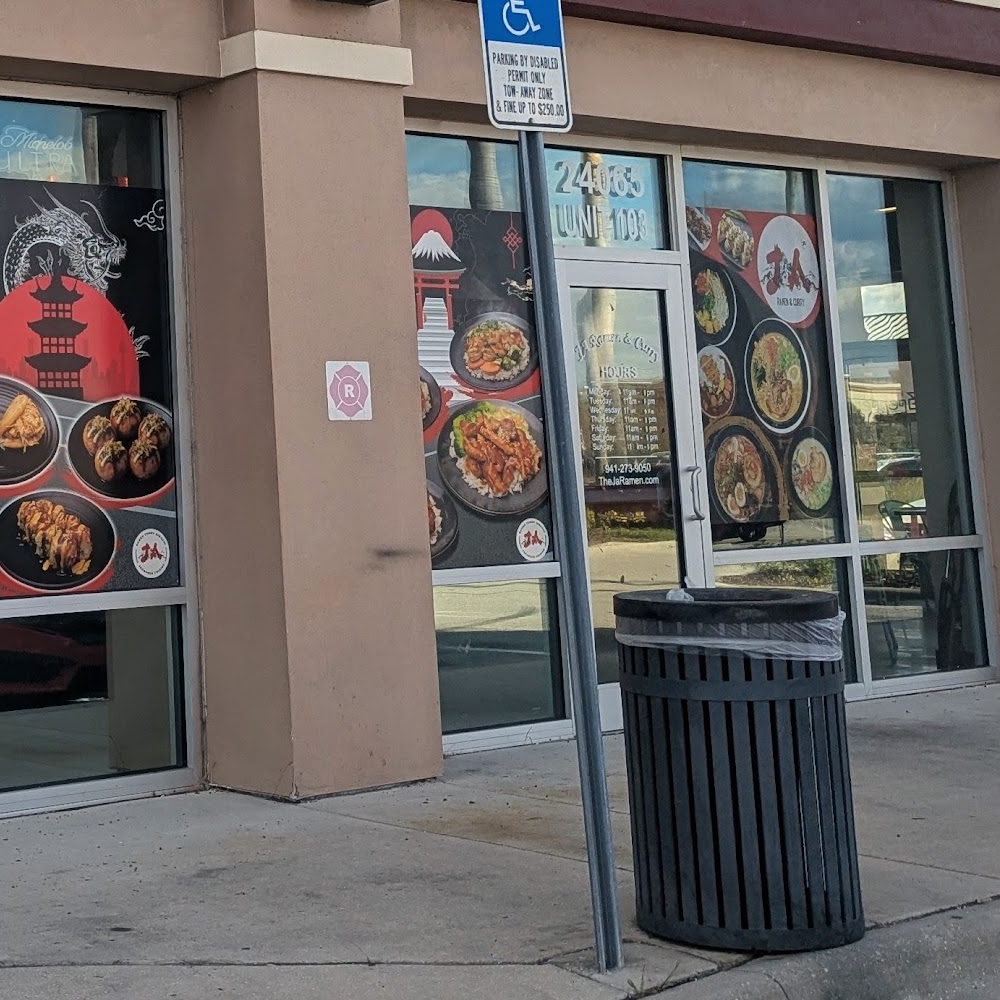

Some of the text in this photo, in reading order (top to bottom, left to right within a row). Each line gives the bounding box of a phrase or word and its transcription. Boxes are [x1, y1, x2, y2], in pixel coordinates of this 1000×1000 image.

[492, 52, 559, 69] PARKING BY DISABLED
[507, 69, 546, 84] PERMIT ONLY
[538, 87, 554, 100] ZONE
[496, 100, 565, 116] & FINE UP TO $250.00
[0, 125, 74, 151] Michelob
[556, 159, 646, 198] 24065
[558, 203, 610, 239] UNIT
[766, 243, 811, 295] JA
[600, 365, 637, 378] HOURS
[344, 383, 355, 398] R
[604, 463, 651, 474] 941-273-9050
[598, 476, 660, 486] TheJaRamen.com
[141, 543, 162, 563] JA
